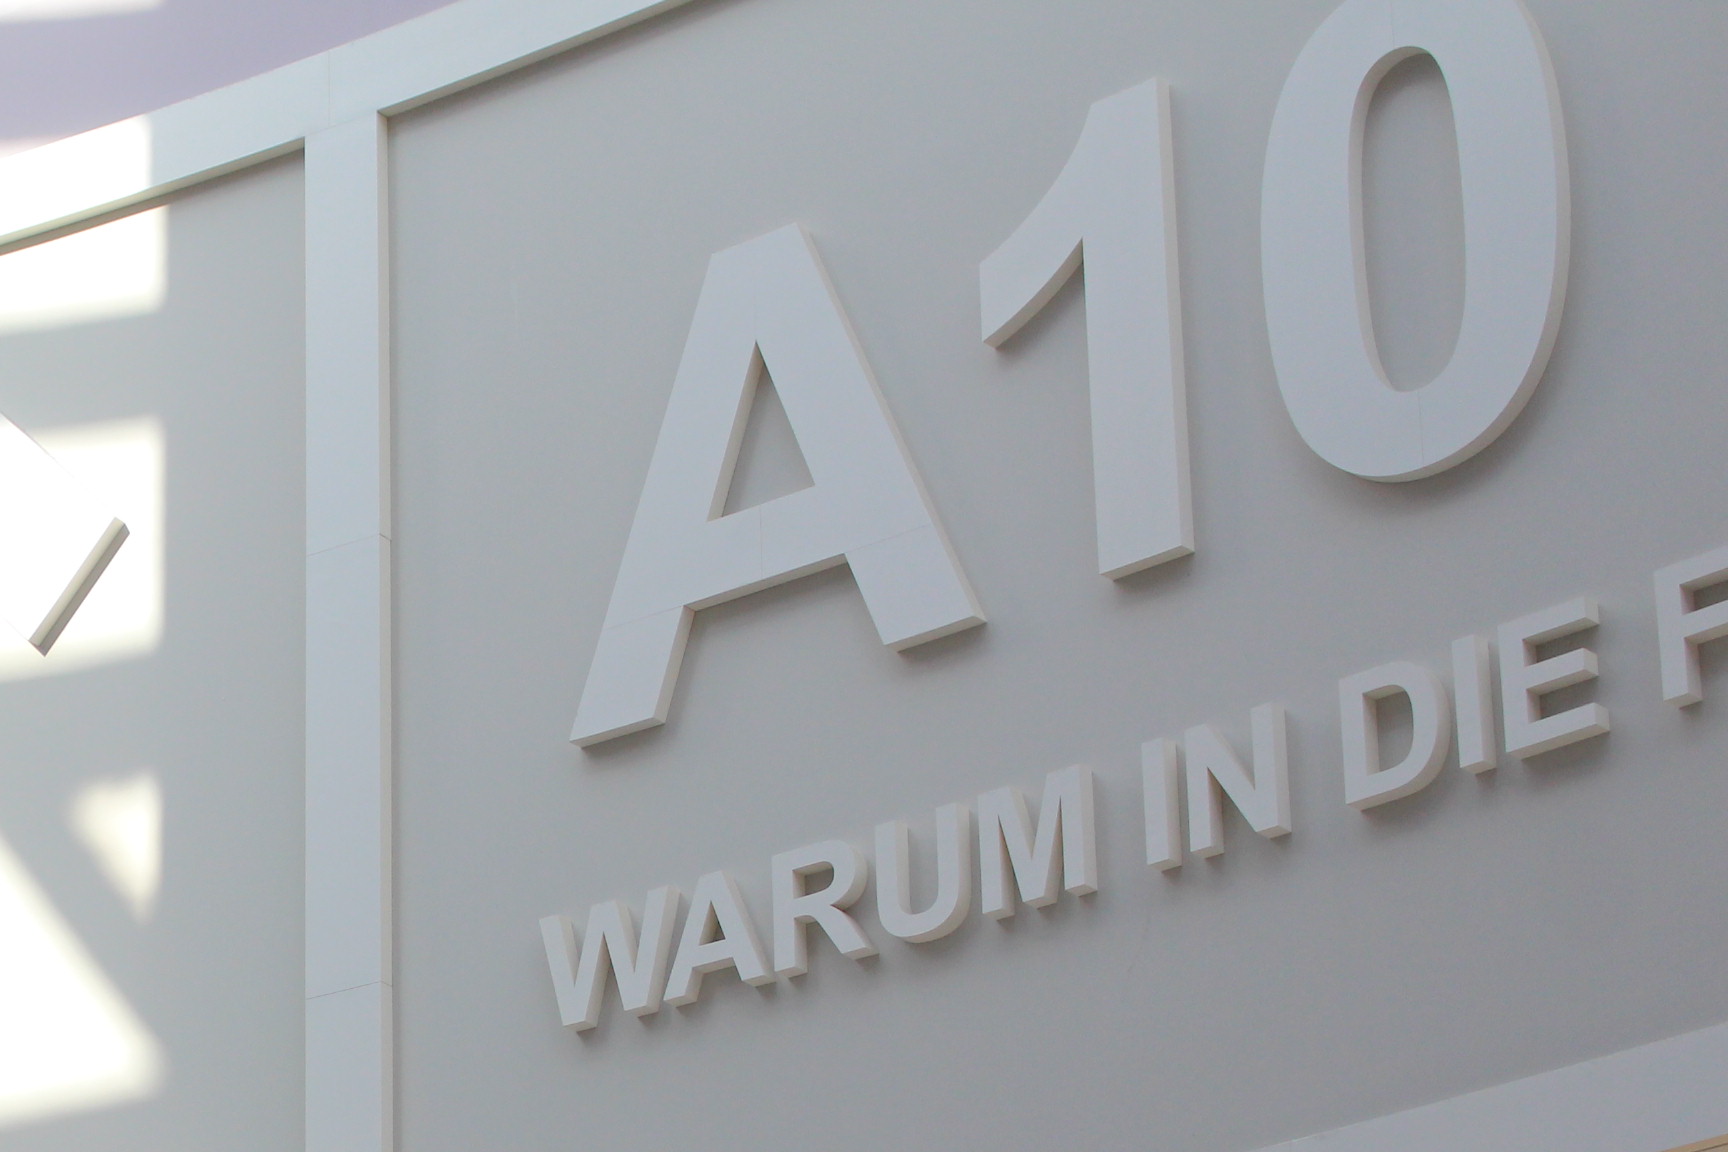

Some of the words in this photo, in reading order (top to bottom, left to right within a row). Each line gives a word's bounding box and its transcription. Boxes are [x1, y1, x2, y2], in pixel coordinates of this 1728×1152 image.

[569, 0, 1571, 749] A10
[539, 764, 1098, 1032] WARUM
[1141, 701, 1292, 870] IN
[1338, 598, 1611, 811] DIE
